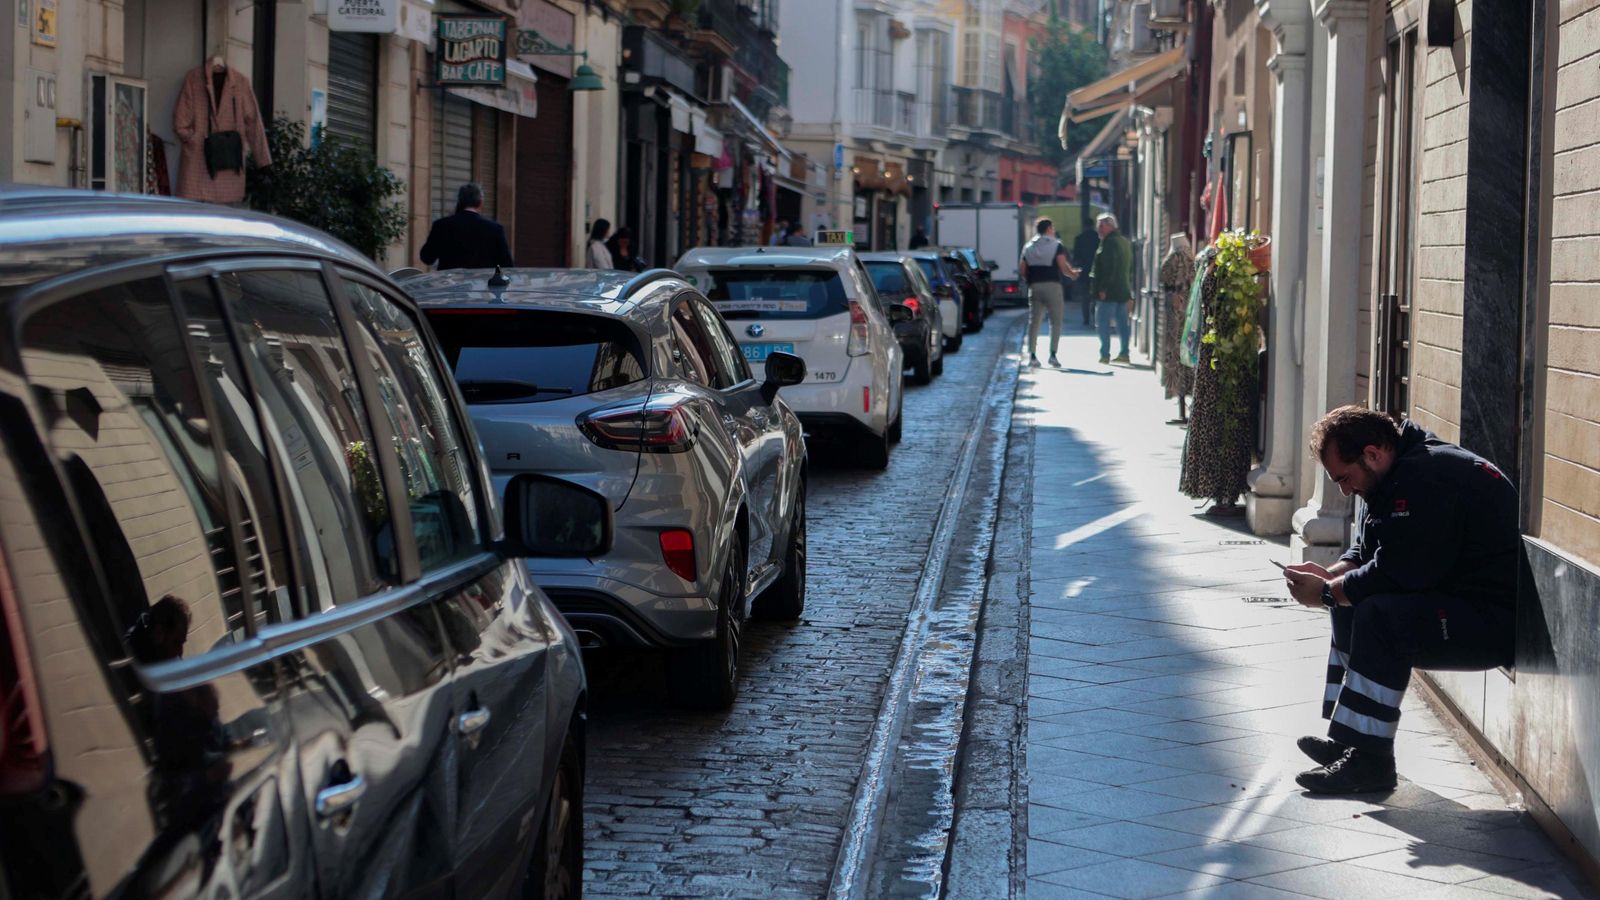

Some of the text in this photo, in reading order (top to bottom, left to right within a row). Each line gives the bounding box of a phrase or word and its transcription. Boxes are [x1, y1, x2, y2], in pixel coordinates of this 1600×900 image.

[338, 7, 386, 16] CATEDRAL
[445, 38, 499, 62] LAGARTO
[826, 232, 845, 243] TAXI
[815, 371, 836, 380] 1470
